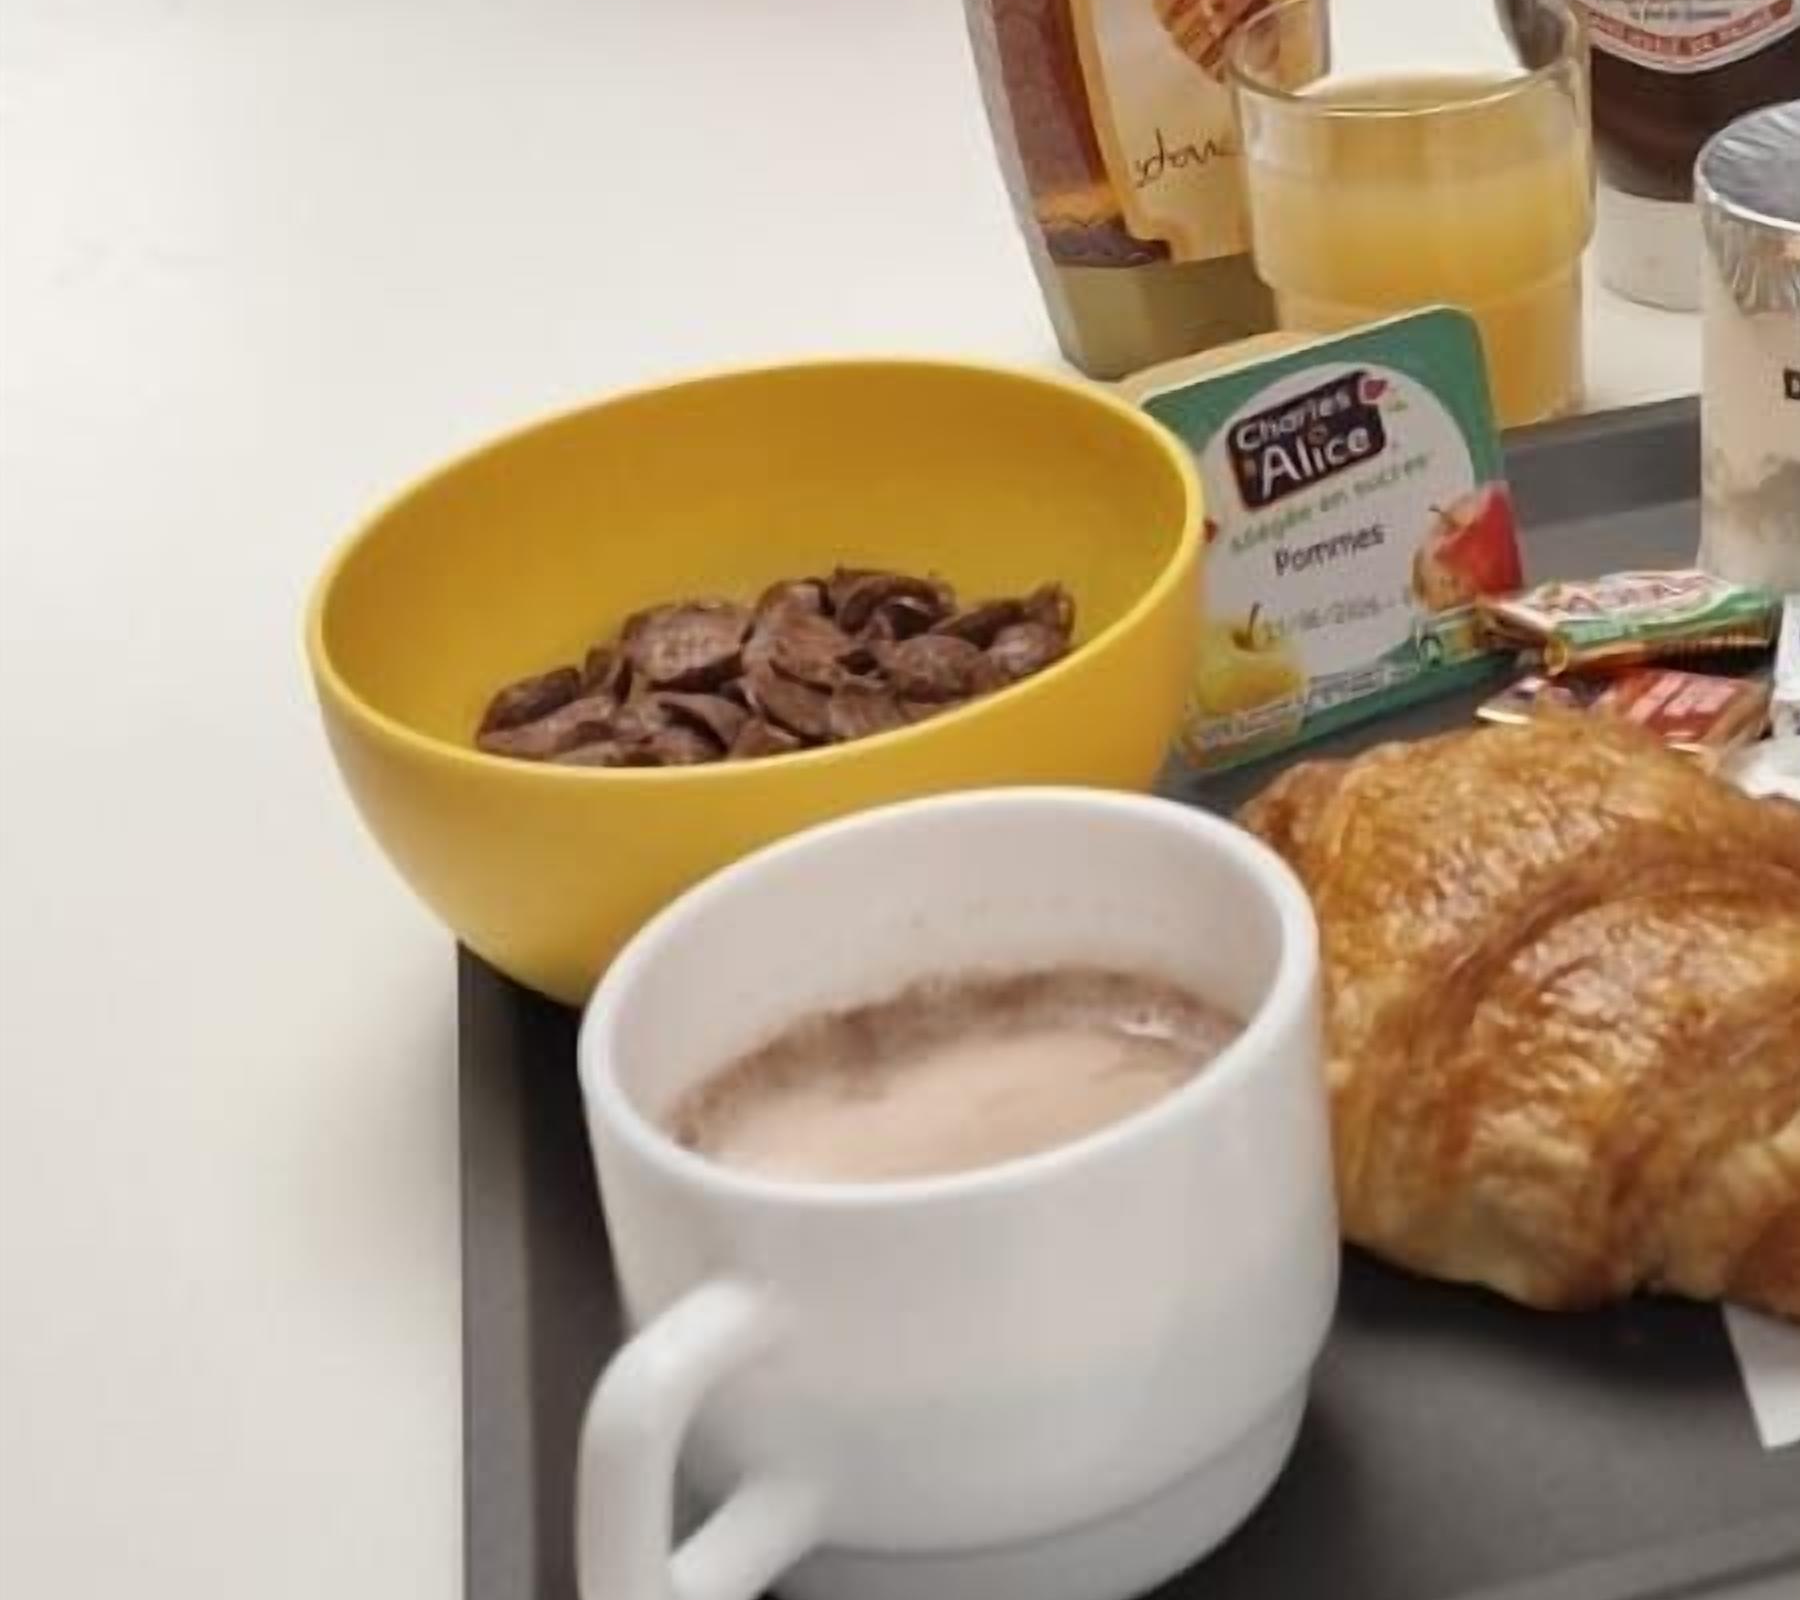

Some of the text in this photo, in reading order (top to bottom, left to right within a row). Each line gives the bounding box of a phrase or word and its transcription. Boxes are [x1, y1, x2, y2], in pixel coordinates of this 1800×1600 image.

[1235, 390, 1352, 453] Charles
[1260, 427, 1372, 500] Alice
[1274, 521, 1387, 578] Pommes
